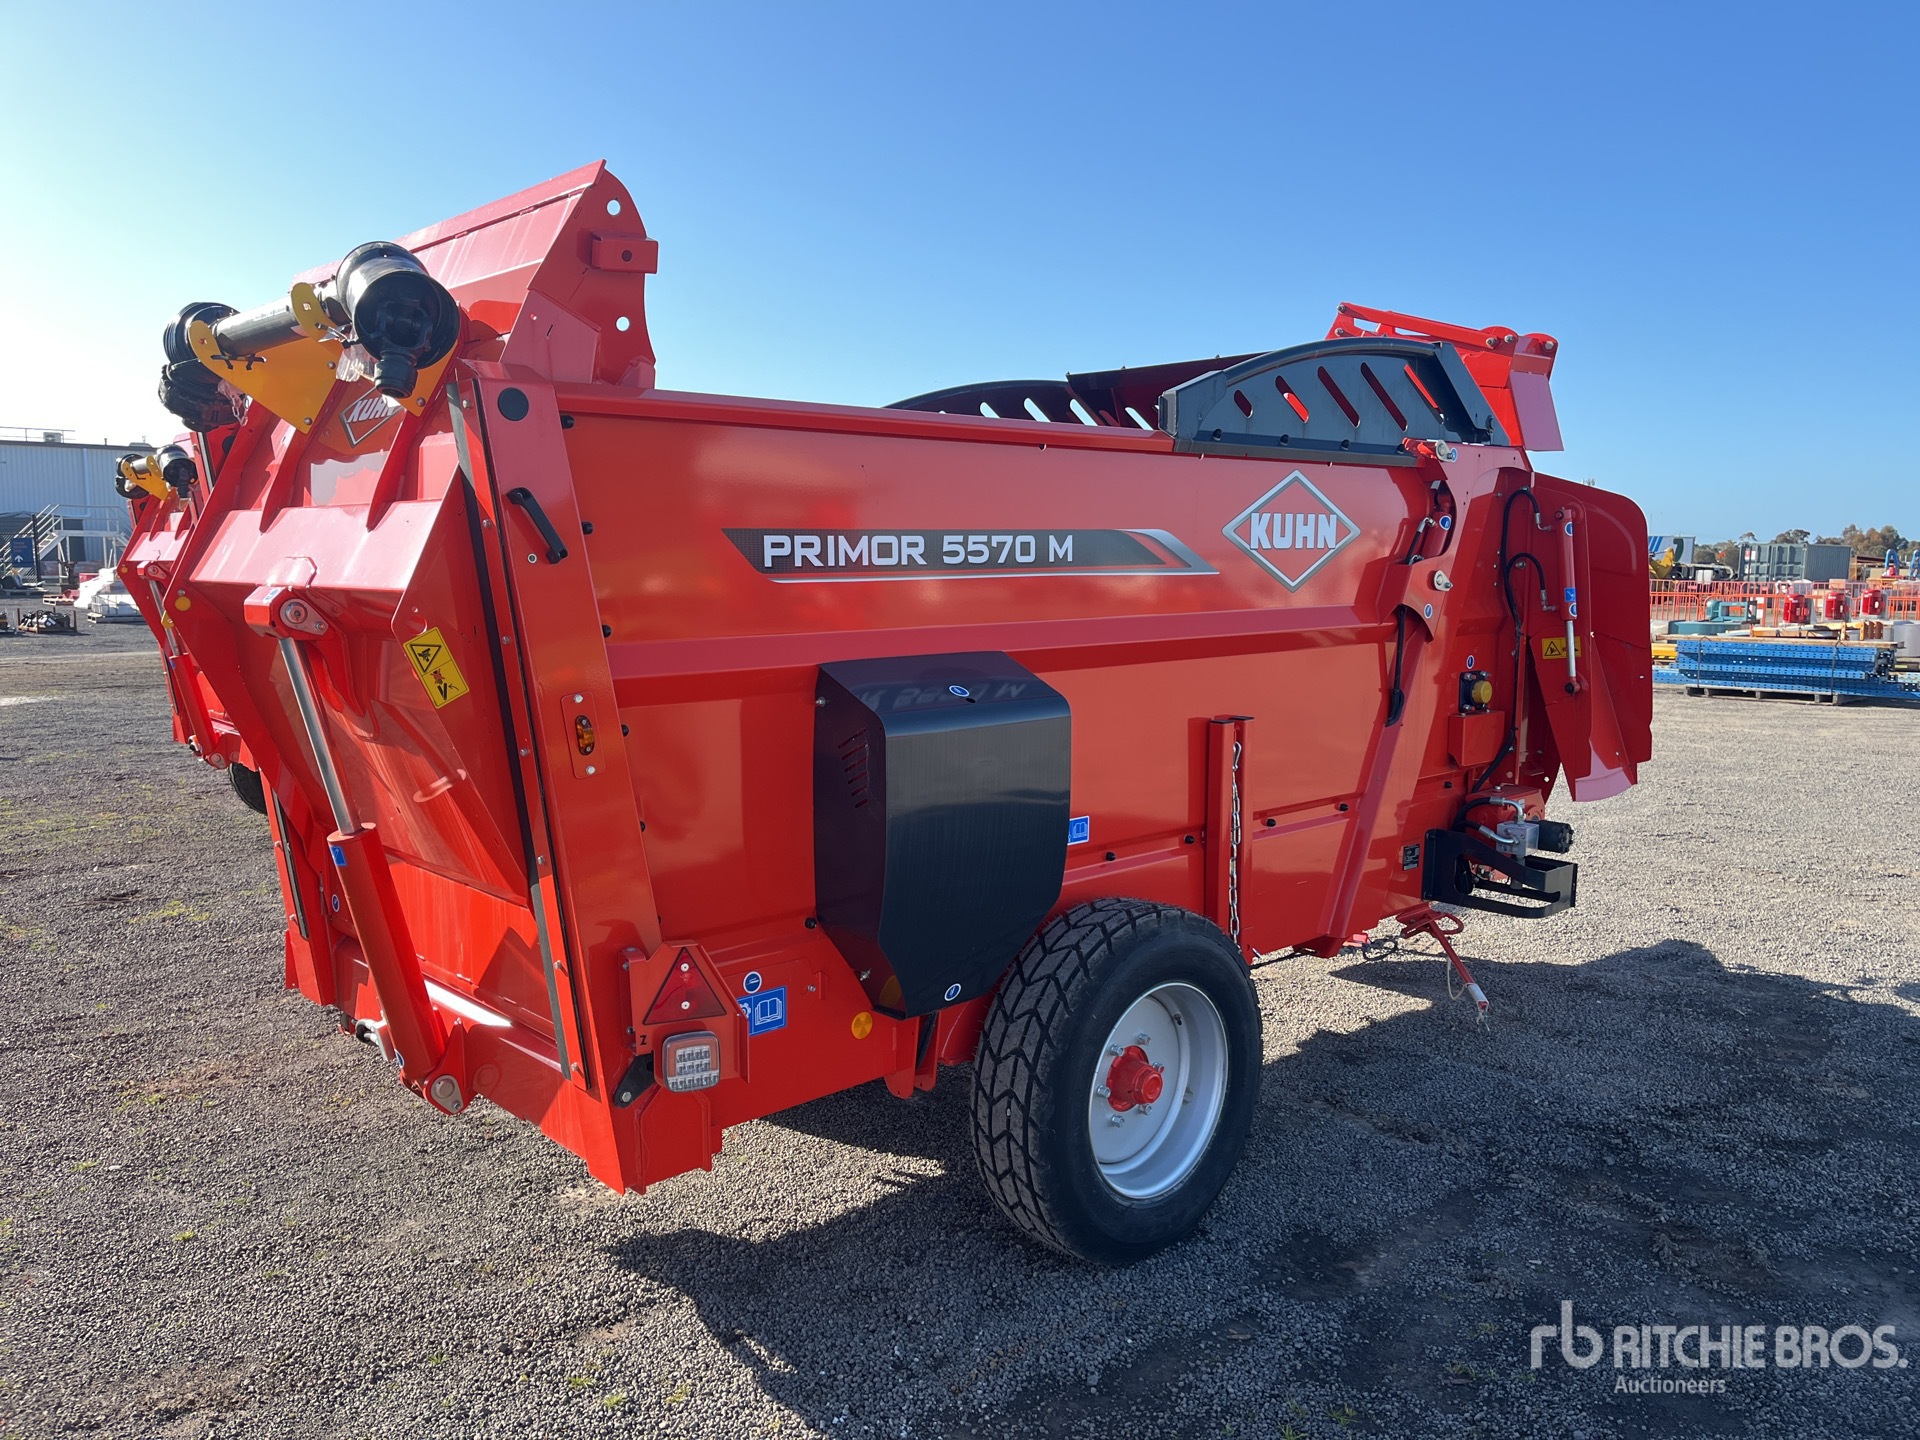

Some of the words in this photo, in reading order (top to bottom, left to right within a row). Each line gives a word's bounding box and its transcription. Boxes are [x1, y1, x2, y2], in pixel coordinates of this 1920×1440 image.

[1249, 512, 1338, 550] KUHN
[763, 534, 927, 568] PRIMOR
[942, 534, 1036, 565] 5570
[1048, 534, 1073, 563] M
